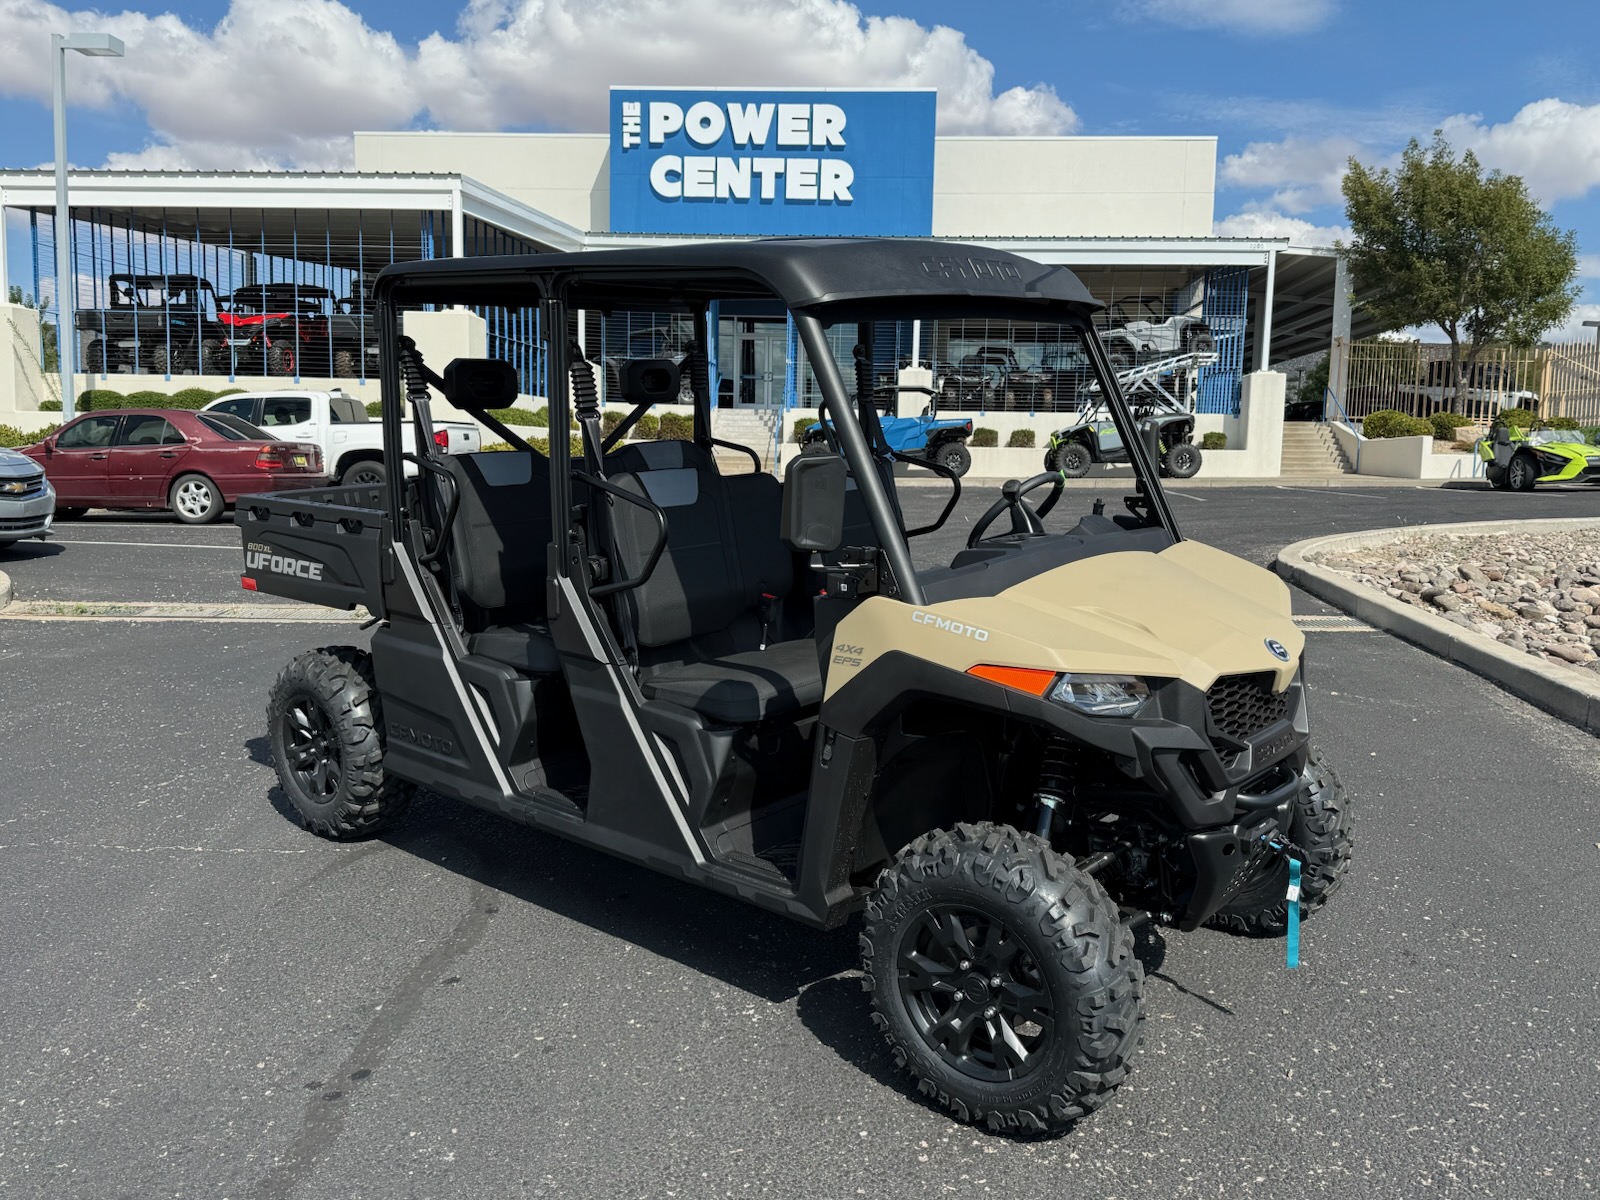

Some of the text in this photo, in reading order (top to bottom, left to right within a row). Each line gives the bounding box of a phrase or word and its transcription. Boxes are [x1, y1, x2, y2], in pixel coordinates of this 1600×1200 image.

[622, 101, 641, 148] THE
[649, 101, 847, 146] POWER
[649, 155, 854, 200] CENTER
[919, 256, 1022, 281] CFMOTO
[246, 551, 324, 581] UFORCE
[911, 610, 989, 642] CFMOTO
[833, 655, 862, 667] EPS
[835, 644, 864, 656] 4X4
